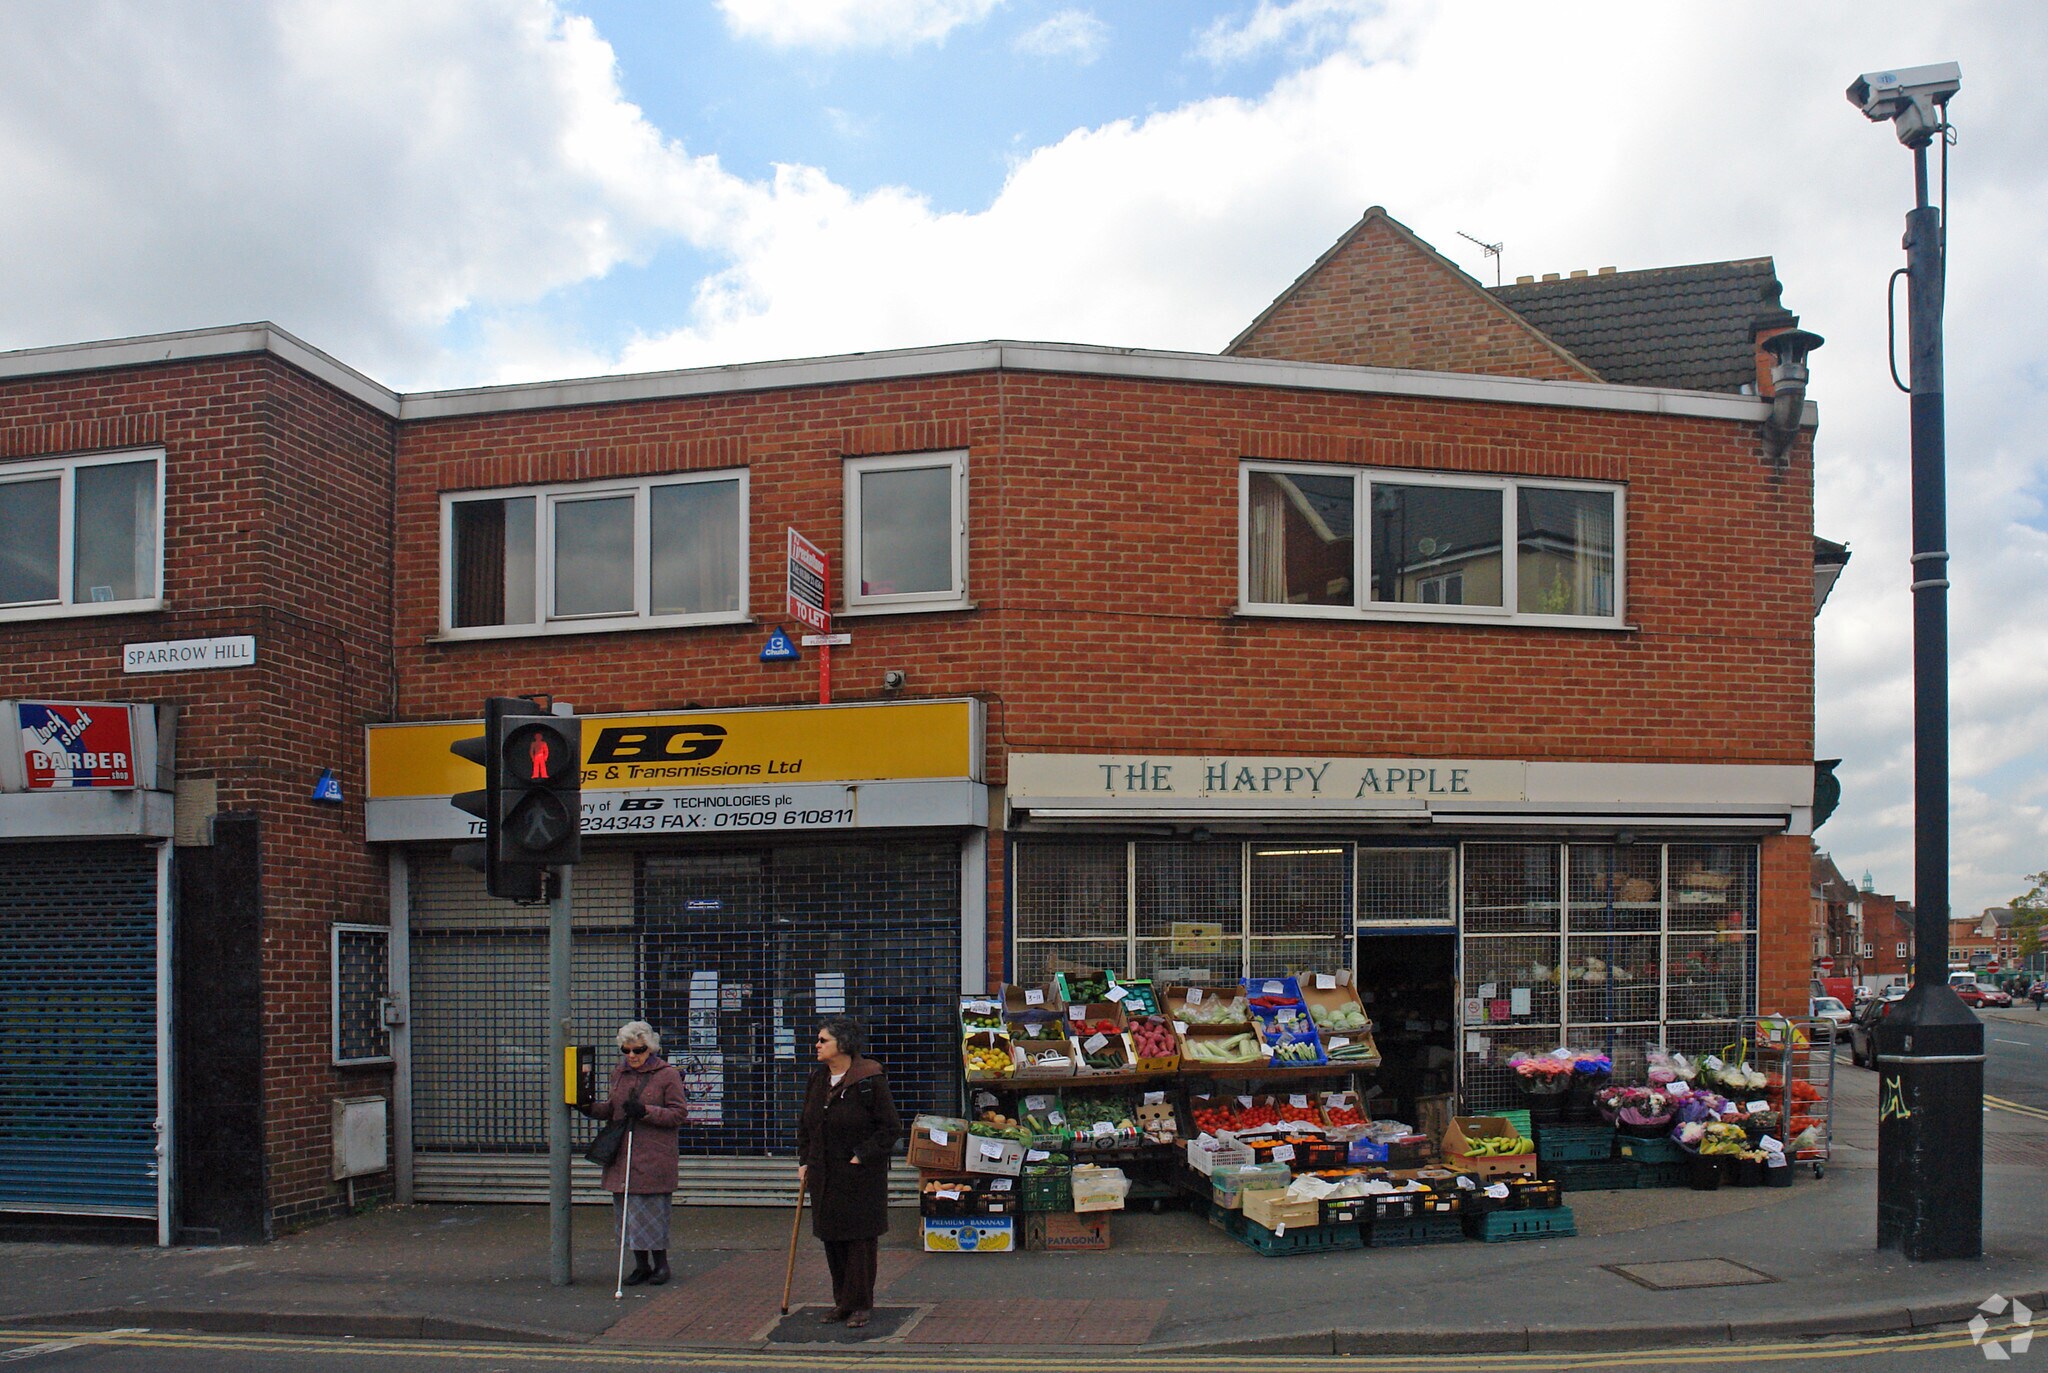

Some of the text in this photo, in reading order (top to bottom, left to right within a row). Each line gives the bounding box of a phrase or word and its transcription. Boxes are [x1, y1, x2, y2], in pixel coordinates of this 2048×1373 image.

[796, 601, 825, 629] TO LET
[128, 643, 250, 665] SPARROW HILL
[587, 723, 728, 765] BG
[32, 752, 128, 770] BARBER
[604, 766, 620, 779] &
[627, 762, 762, 779] Transmissions
[767, 759, 803, 774] Ltd
[111, 770, 129, 781] shop
[1098, 759, 1472, 799] THE HAPPY APPLE
[599, 800, 611, 811] of
[618, 798, 665, 811] BG
[673, 795, 770, 808] TECHNOLOGIES
[775, 794, 792, 807] plc
[580, 816, 655, 831] 234343
[661, 814, 707, 829] FAX:
[714, 812, 776, 827] 01509
[783, 809, 854, 825] 610811
[1047, 1236, 1105, 1245] PATAGONIA
